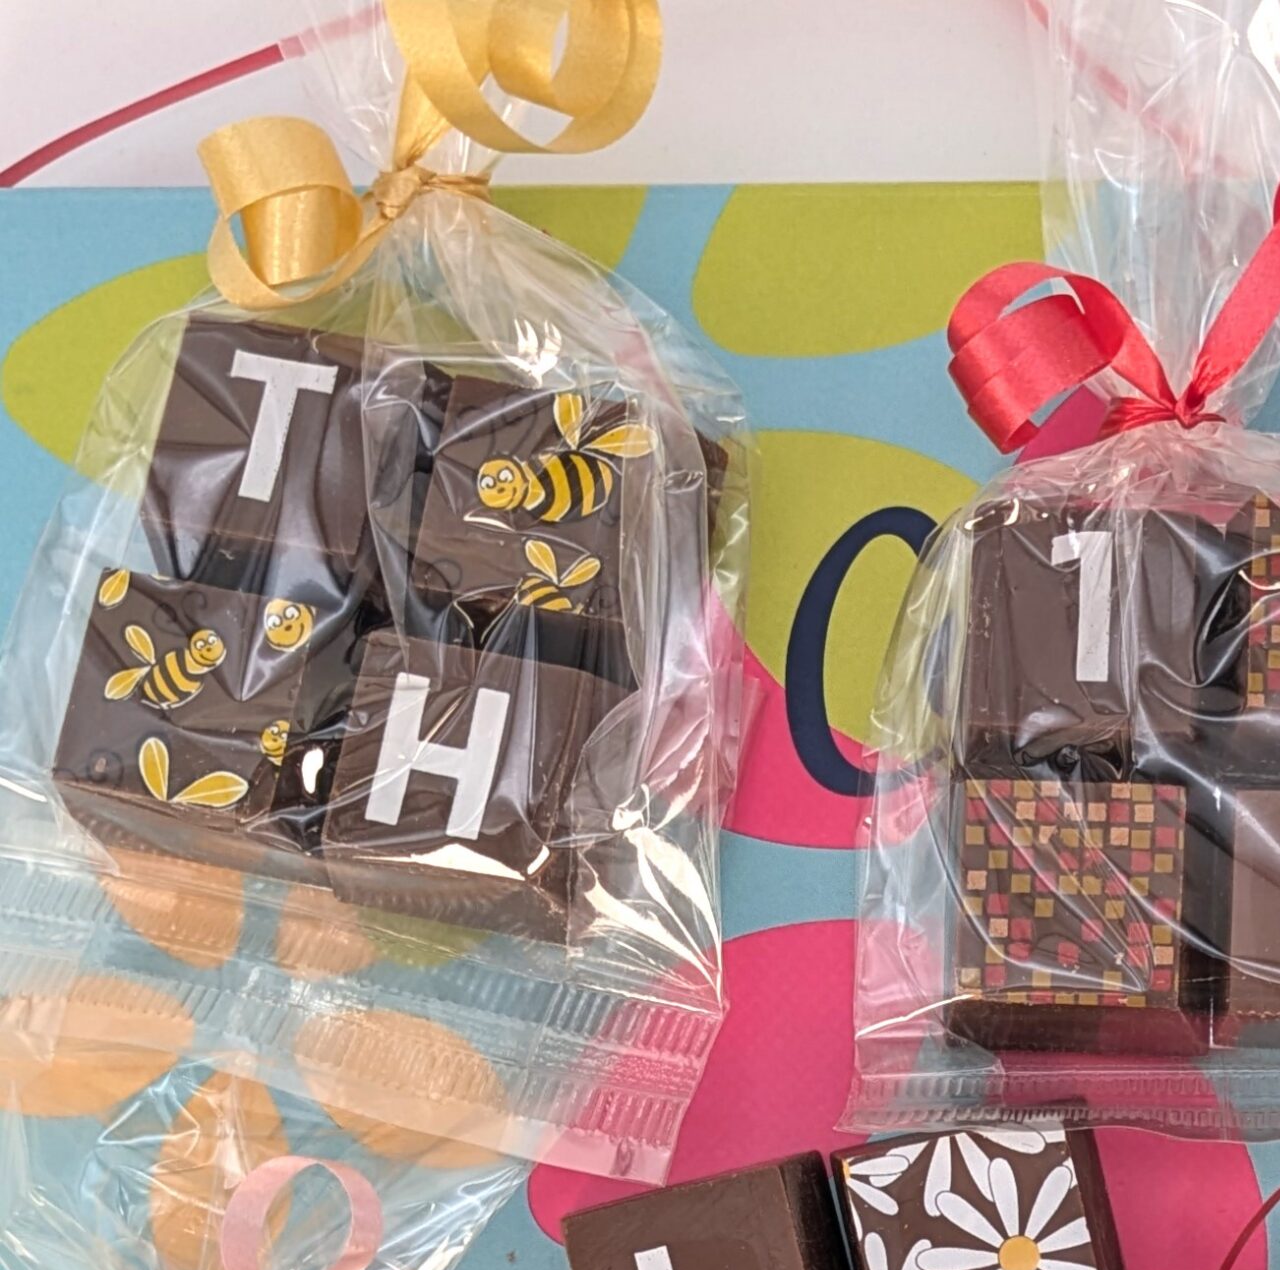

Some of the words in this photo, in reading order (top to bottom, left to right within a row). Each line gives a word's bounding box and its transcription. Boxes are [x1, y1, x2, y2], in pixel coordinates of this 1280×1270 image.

[231, 350, 338, 501] T
[1051, 531, 1113, 683] 1
[365, 673, 510, 840] H
